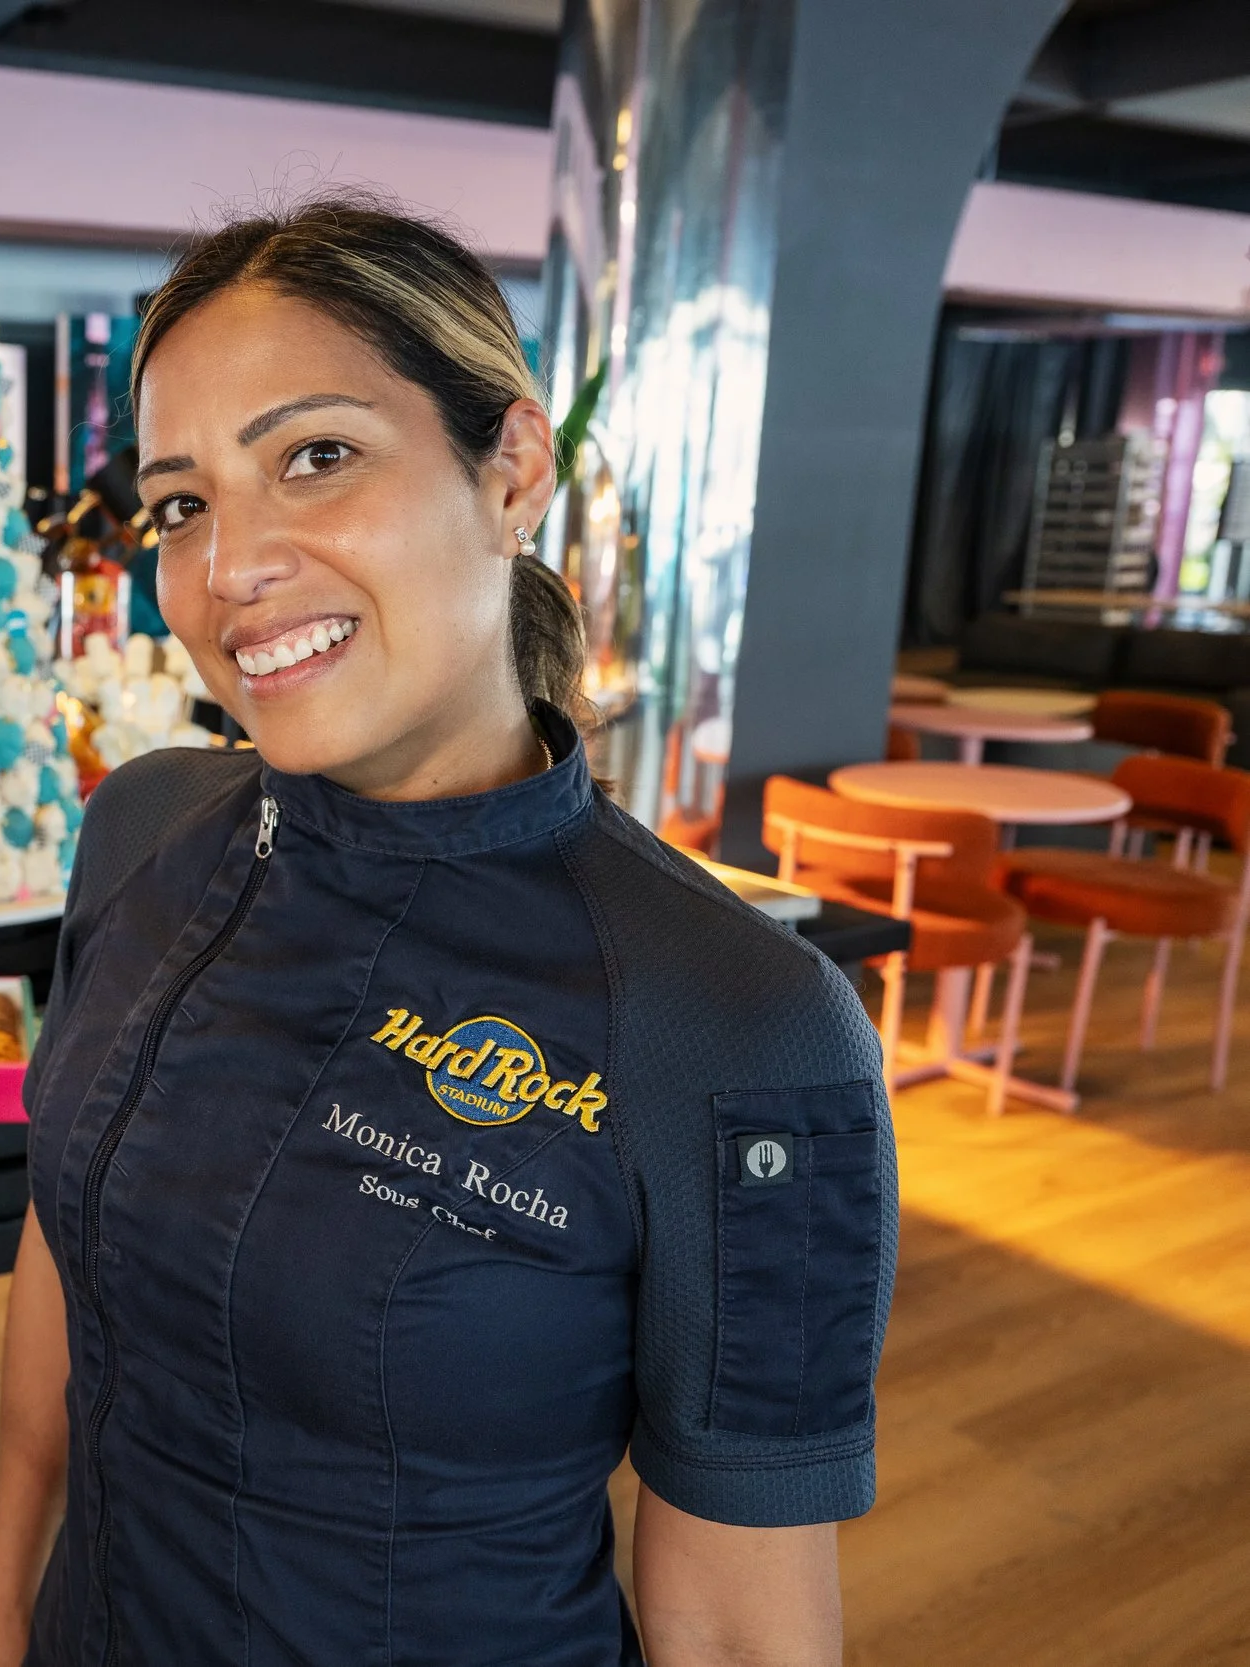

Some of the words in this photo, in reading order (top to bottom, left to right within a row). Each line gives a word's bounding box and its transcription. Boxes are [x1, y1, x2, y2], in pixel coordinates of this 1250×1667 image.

[370, 1008, 496, 1080] Hard
[481, 1047, 608, 1132] Rock
[437, 1084, 509, 1118] STADIUM
[322, 1104, 441, 1175] Monica
[461, 1160, 568, 1229] Rocha
[359, 1175, 420, 1209] Sous
